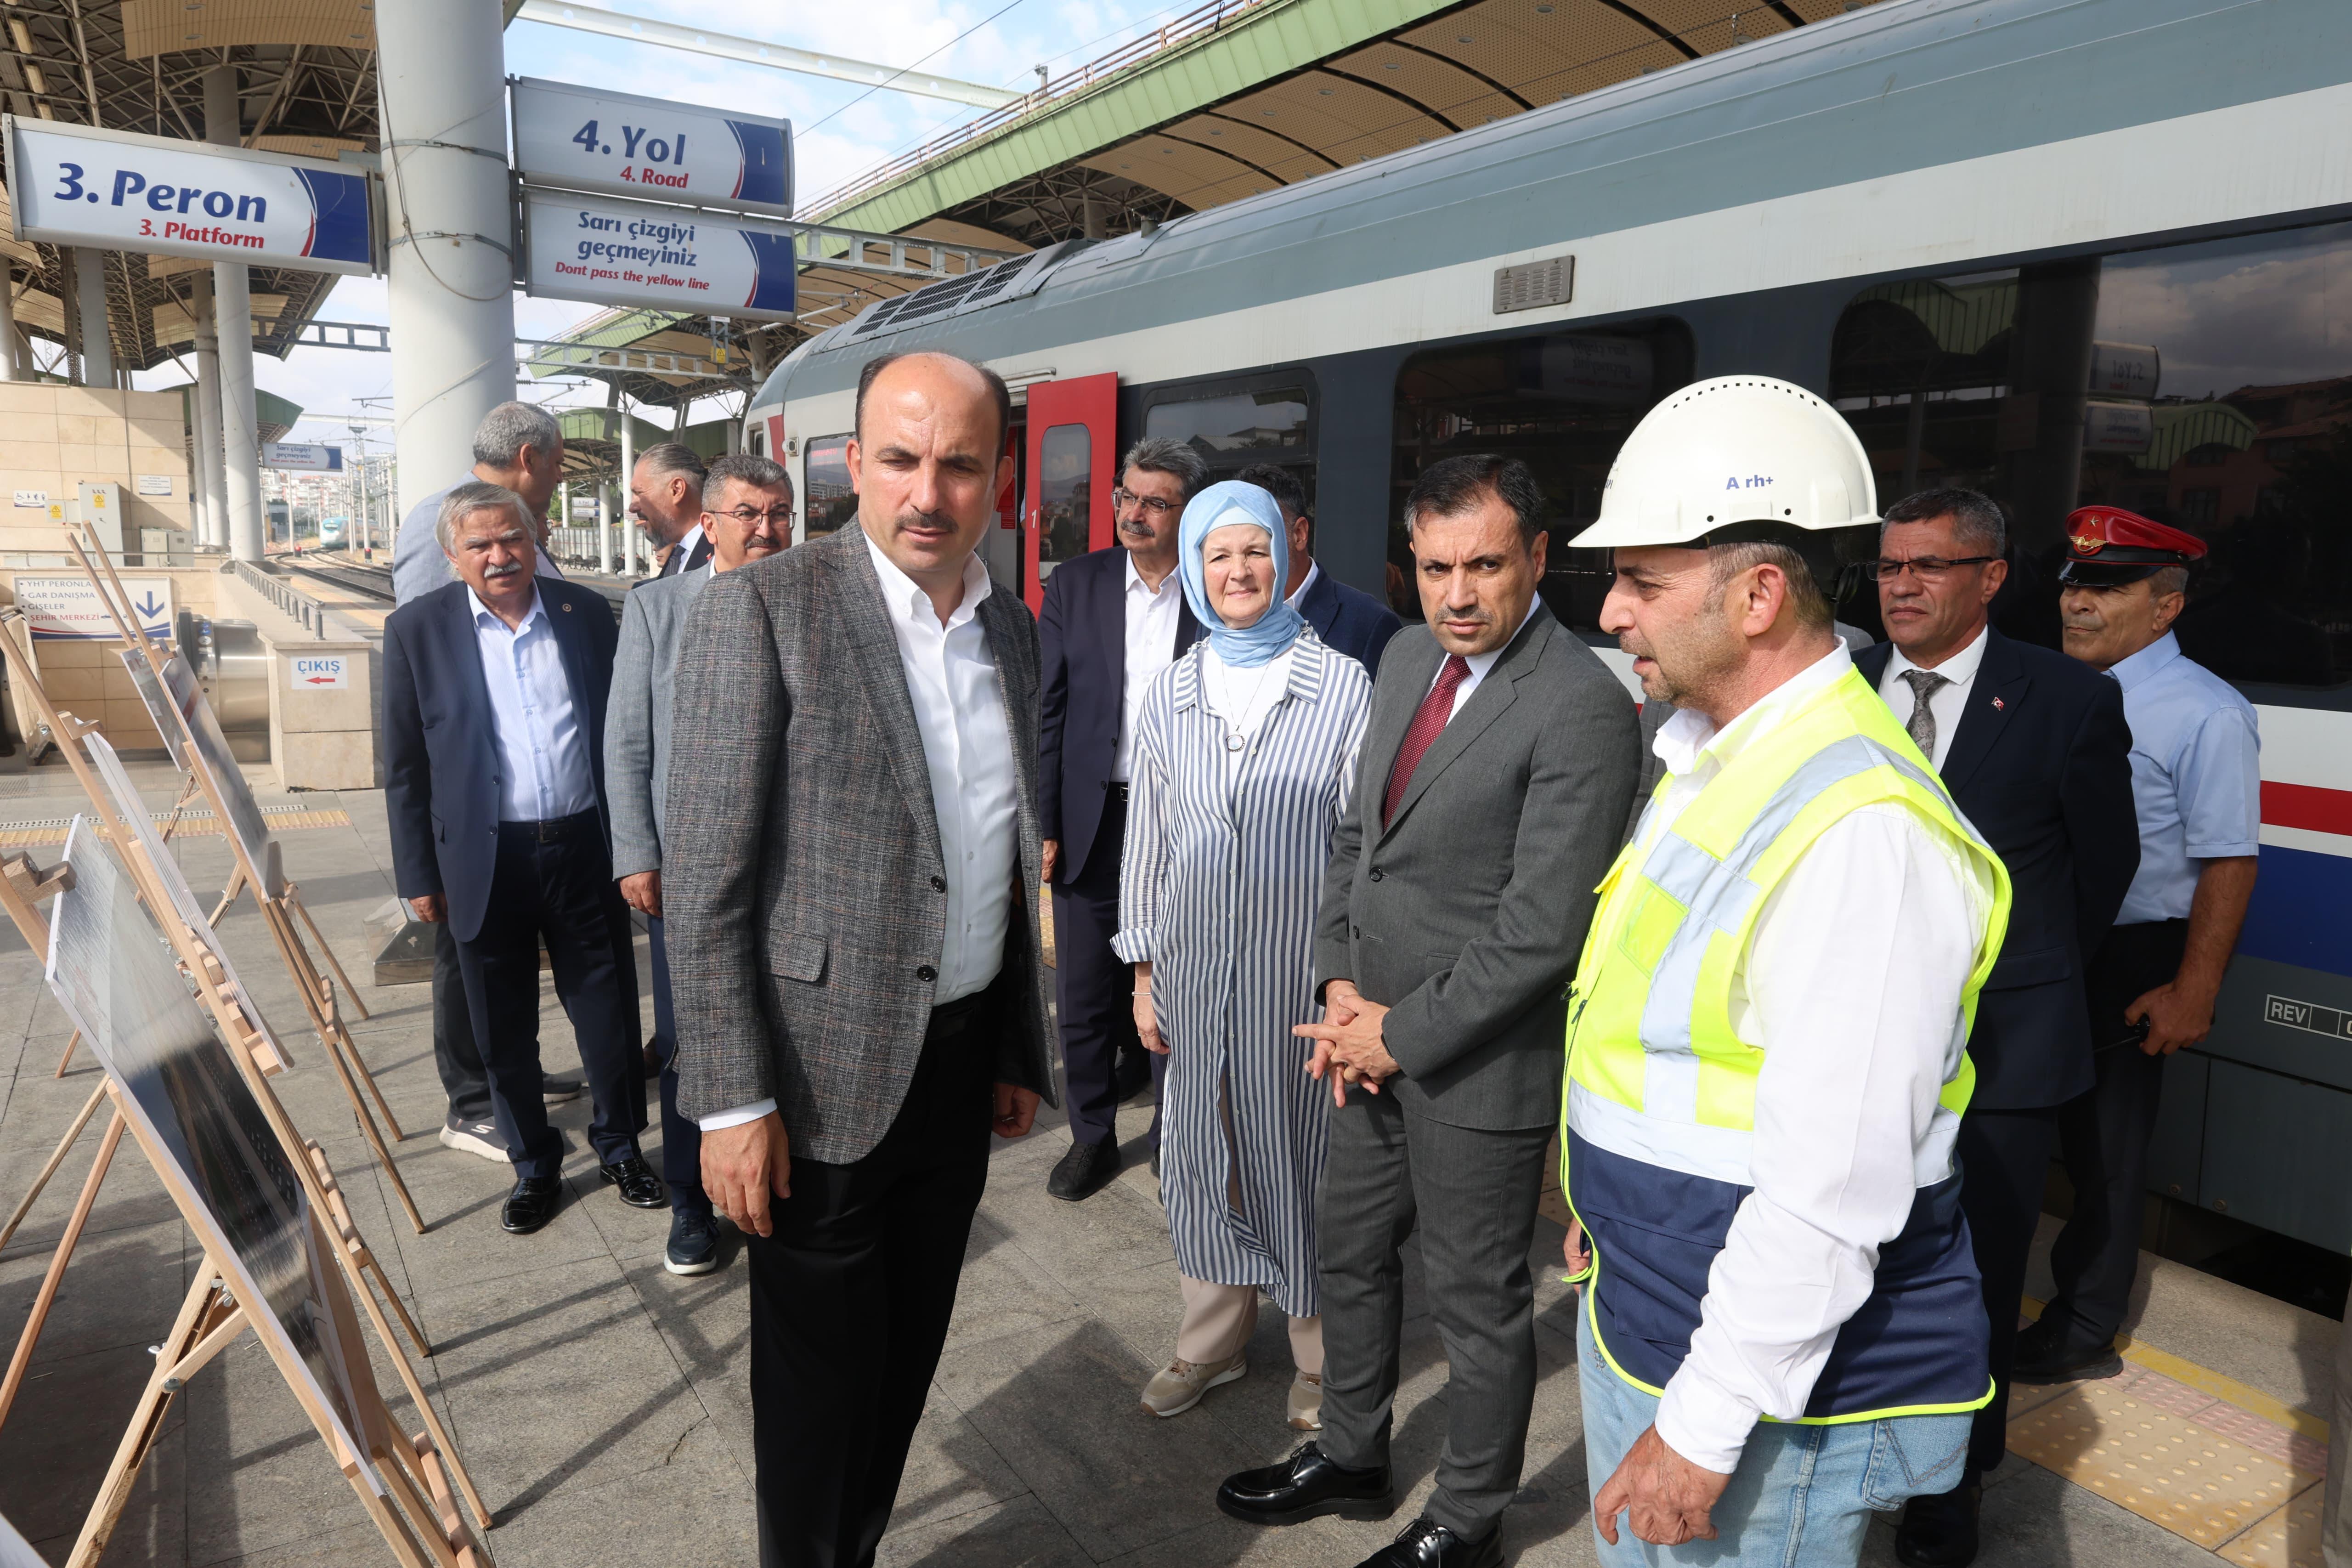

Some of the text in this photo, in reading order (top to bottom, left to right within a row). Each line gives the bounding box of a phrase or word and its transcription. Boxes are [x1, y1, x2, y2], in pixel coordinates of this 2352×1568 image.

[622, 125, 686, 165] Yol
[620, 166, 689, 189] 4. Road
[139, 219, 265, 249] 3. Platform
[578, 211, 695, 245] Sarı çizgiyi
[577, 240, 697, 267] geçmeyiniz
[555, 261, 710, 290] Dont pass the yellow line
[1726, 474, 1774, 490] A rh+
[1031, 509, 1037, 529] 1
[28, 602, 65, 611] GİŞELER
[51, 592, 96, 600] DANIŞMA
[30, 612, 100, 622] ŞEHİR MERKEZİ
[298, 660, 340, 674] ÇIKIŞ
[2271, 1002, 2307, 1023] REV
